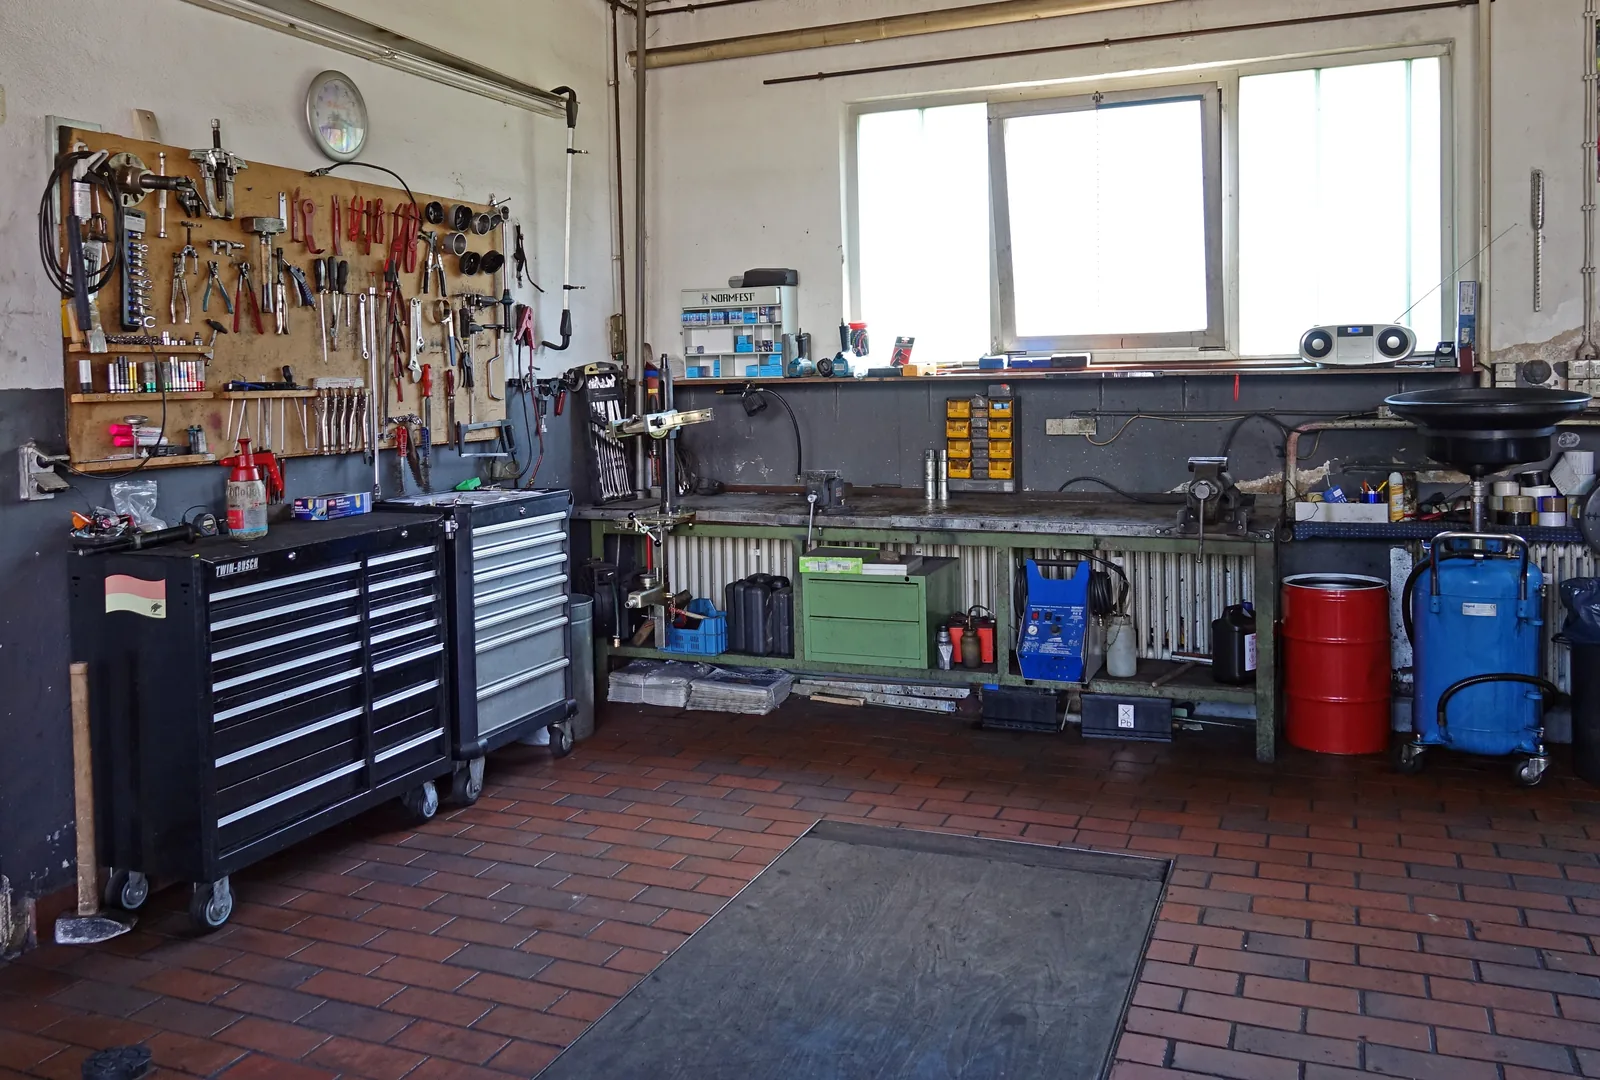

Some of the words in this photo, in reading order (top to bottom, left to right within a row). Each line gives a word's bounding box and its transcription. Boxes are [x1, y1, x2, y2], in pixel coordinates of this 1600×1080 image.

[711, 292, 754, 303] NORMFEST
[216, 557, 259, 577] TWIN-BUSCH
[1120, 719, 1132, 727] Pb
